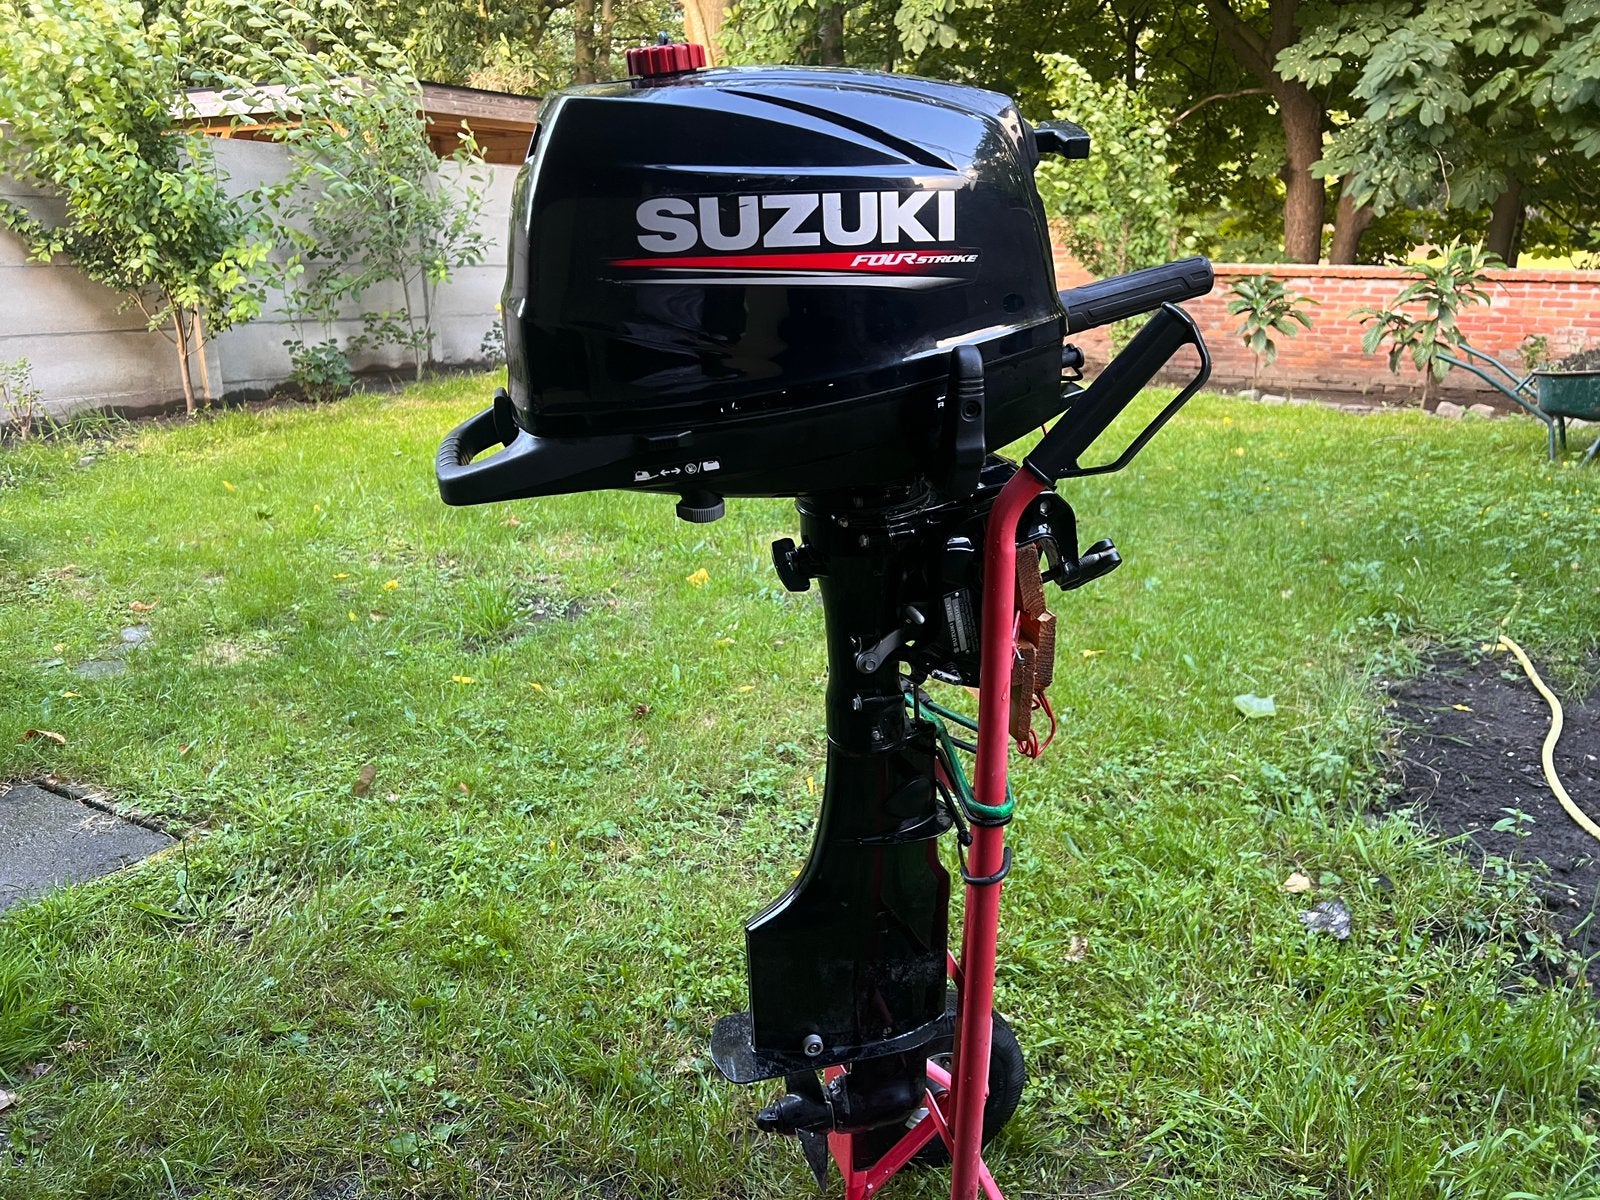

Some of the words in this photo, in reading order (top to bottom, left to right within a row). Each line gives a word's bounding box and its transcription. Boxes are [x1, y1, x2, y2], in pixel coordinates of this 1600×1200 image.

[636, 191, 955, 252] SUZUKI
[850, 253, 917, 267] FOUR
[915, 254, 979, 265] STROKE
